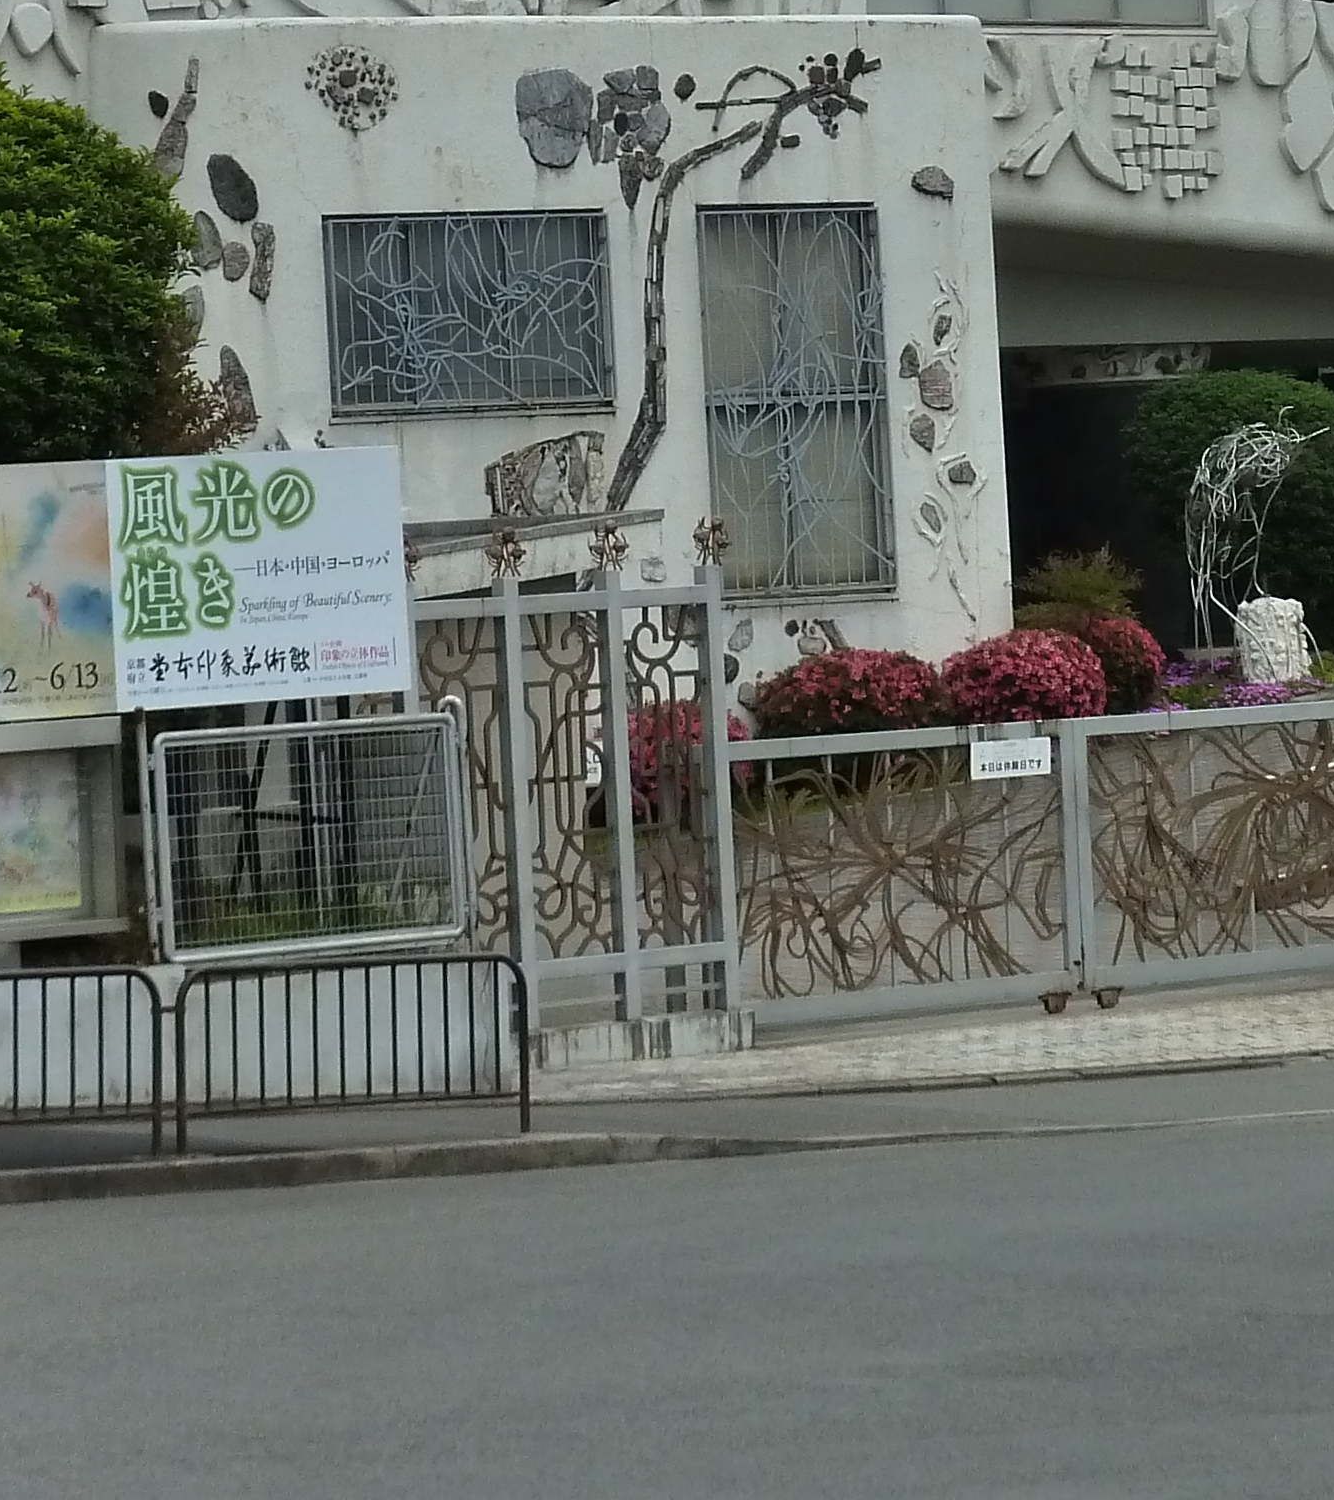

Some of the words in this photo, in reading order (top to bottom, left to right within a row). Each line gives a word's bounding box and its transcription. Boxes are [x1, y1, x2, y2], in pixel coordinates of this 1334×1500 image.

[121, 464, 313, 545] 風光の
[123, 556, 232, 636] 煌き
[239, 597, 287, 615] Sparkling
[289, 594, 302, 612] of
[303, 590, 353, 610] Beautiful
[149, 644, 311, 682] 堂本印象美術館
[980, 758, 1042, 773] 本日は休館日です
